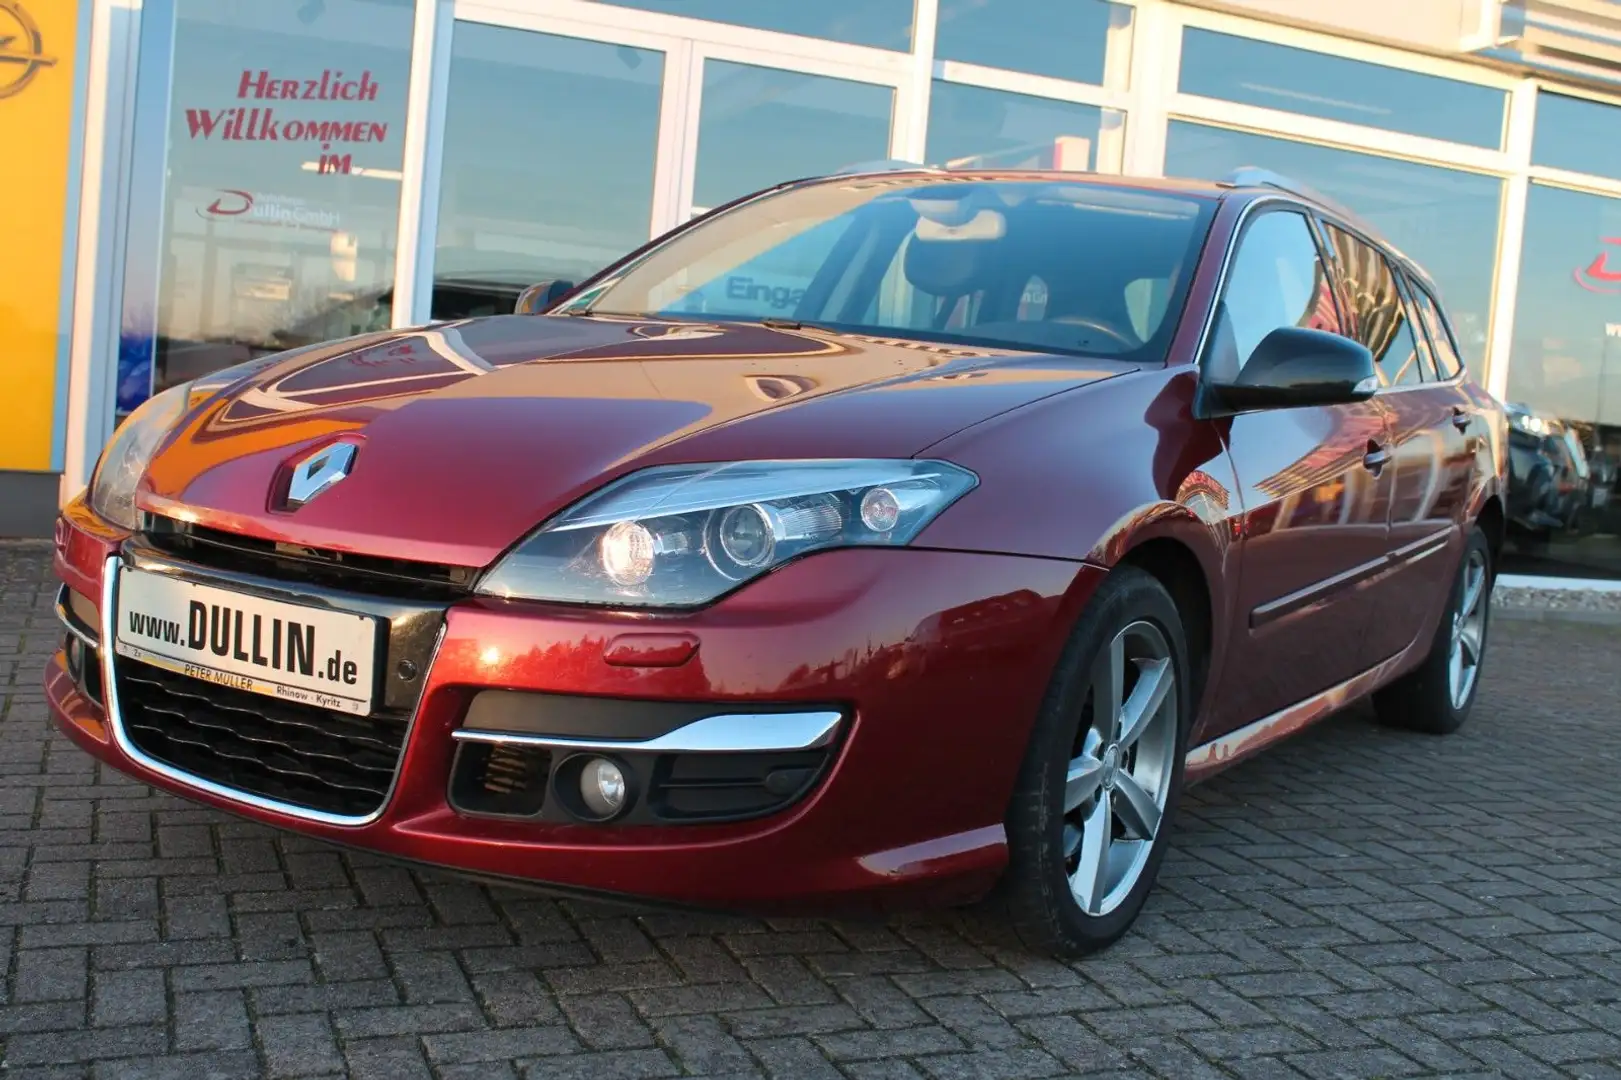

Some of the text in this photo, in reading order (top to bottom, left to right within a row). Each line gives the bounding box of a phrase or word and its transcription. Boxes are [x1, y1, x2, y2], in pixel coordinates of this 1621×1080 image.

[237, 69, 378, 101] Herzlich
[185, 108, 388, 142] Willkommen
[131, 600, 357, 685] www.DULLIN.de
[184, 664, 211, 680] PETER
[276, 685, 308, 701] Rhinow
[316, 694, 341, 708] Kyritz
